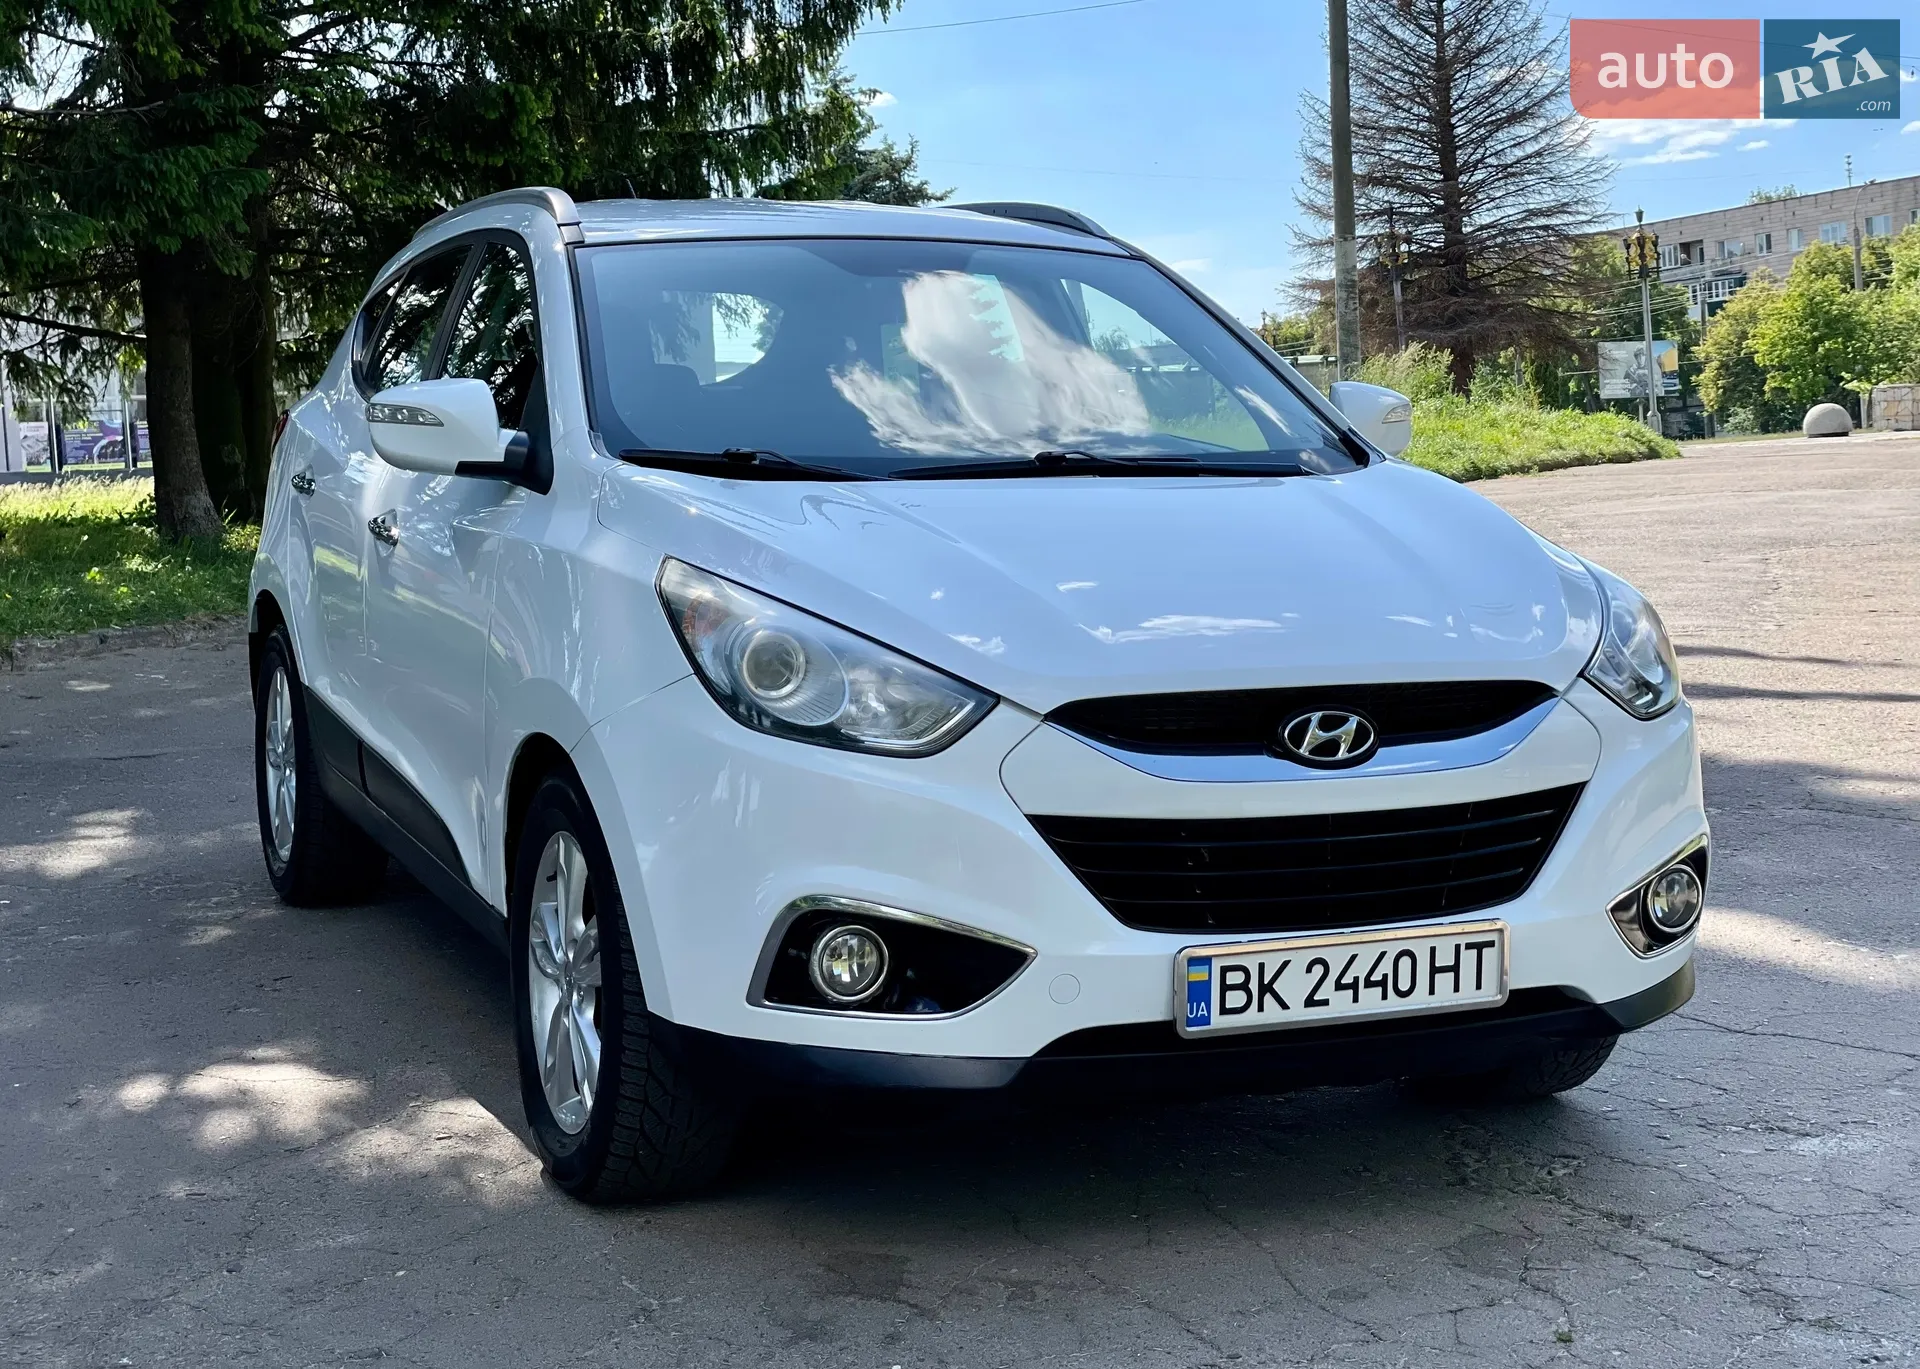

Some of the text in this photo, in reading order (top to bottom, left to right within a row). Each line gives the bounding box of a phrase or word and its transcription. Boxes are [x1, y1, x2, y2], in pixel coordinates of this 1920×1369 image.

[1218, 940, 1496, 1016] BK 2440 HT
[1187, 1001, 1208, 1018] UA
